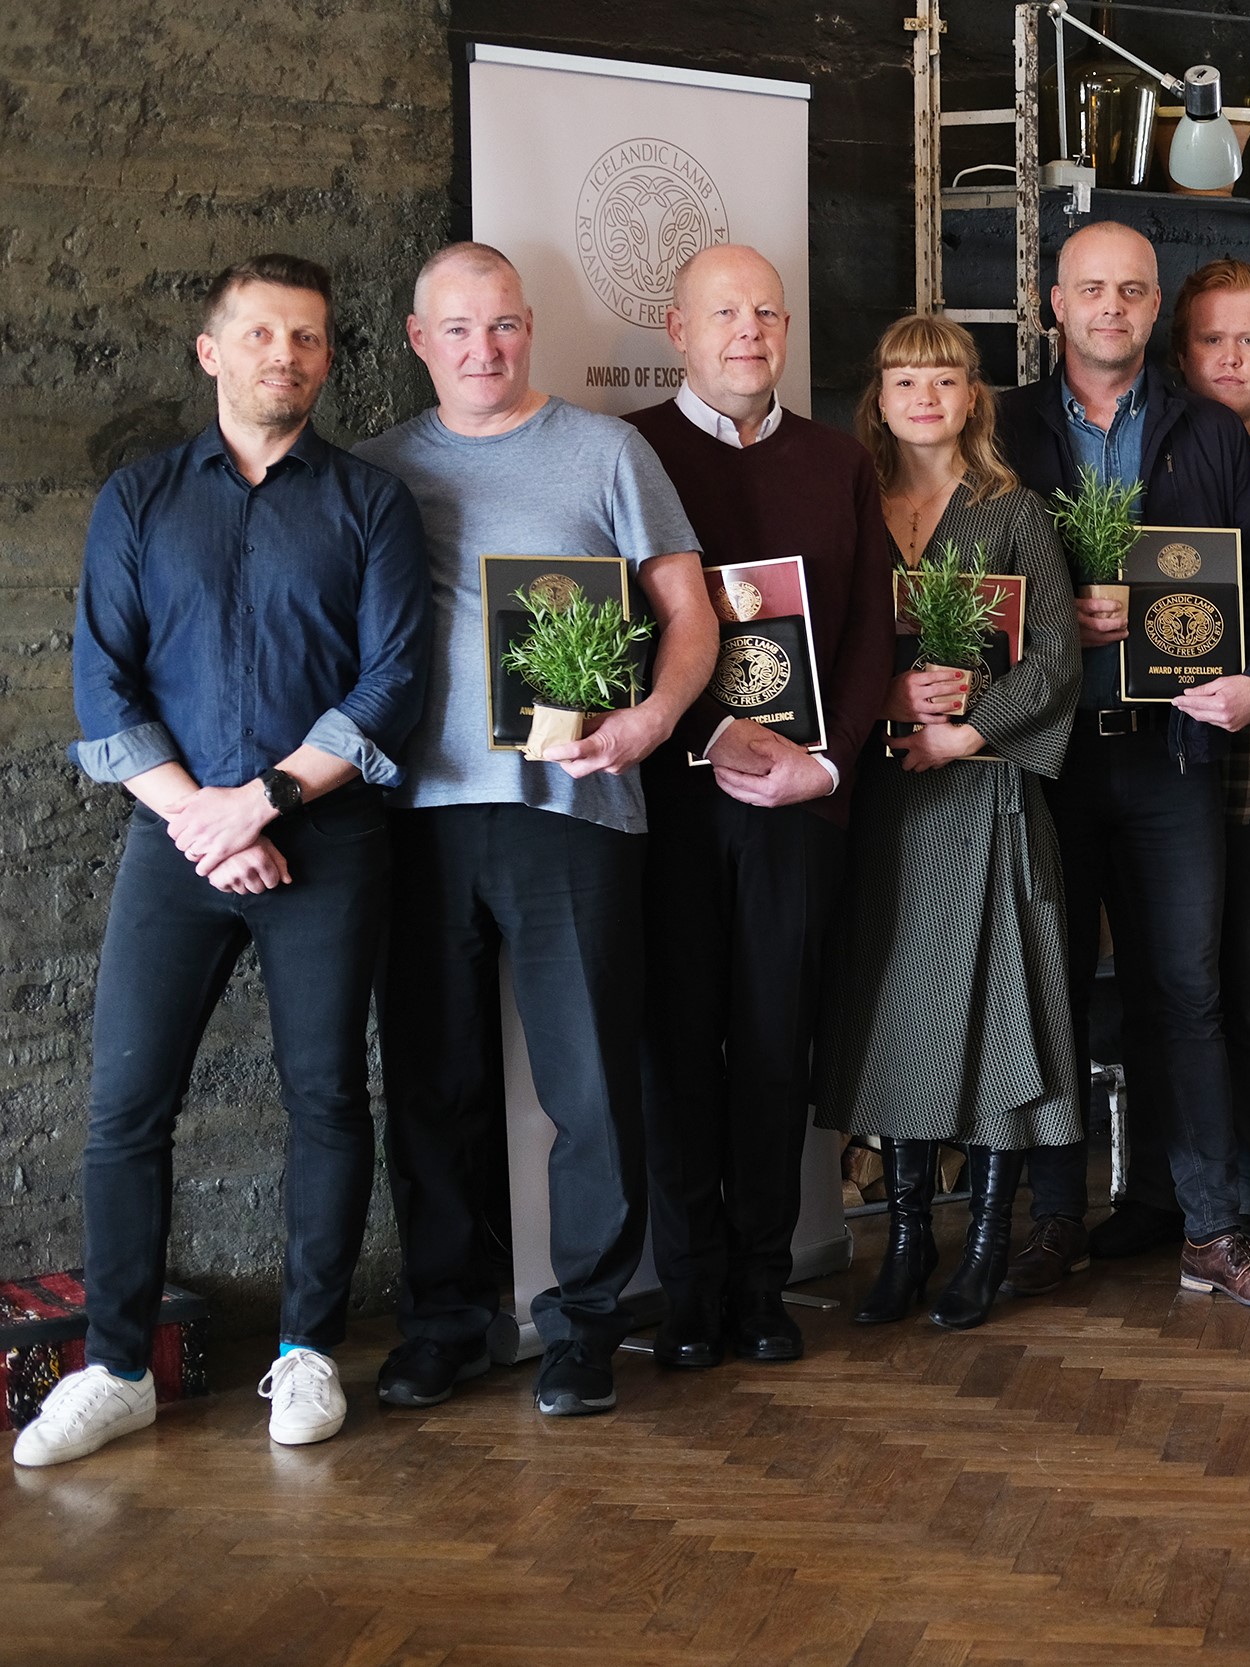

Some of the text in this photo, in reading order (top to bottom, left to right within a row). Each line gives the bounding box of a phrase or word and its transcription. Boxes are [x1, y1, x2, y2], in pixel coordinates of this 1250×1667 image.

[589, 143, 713, 200] ICELANDIC LAMB
[578, 215, 633, 318] ROAMING
[586, 366, 631, 387] AWARD
[634, 366, 651, 387] OF
[1152, 596, 1215, 614] ICELANDIC LAMB
[721, 638, 780, 656] LANDIC LAMB
[1146, 620, 1175, 654] ROAMING
[1177, 648, 1196, 656] FREE
[1196, 636, 1218, 654] SINCE
[1149, 666, 1223, 675] AWARD OF EXCELLENCE
[1178, 675, 1195, 684] 2020
[740, 695, 761, 706] FREE
[762, 679, 785, 701] SINCE
